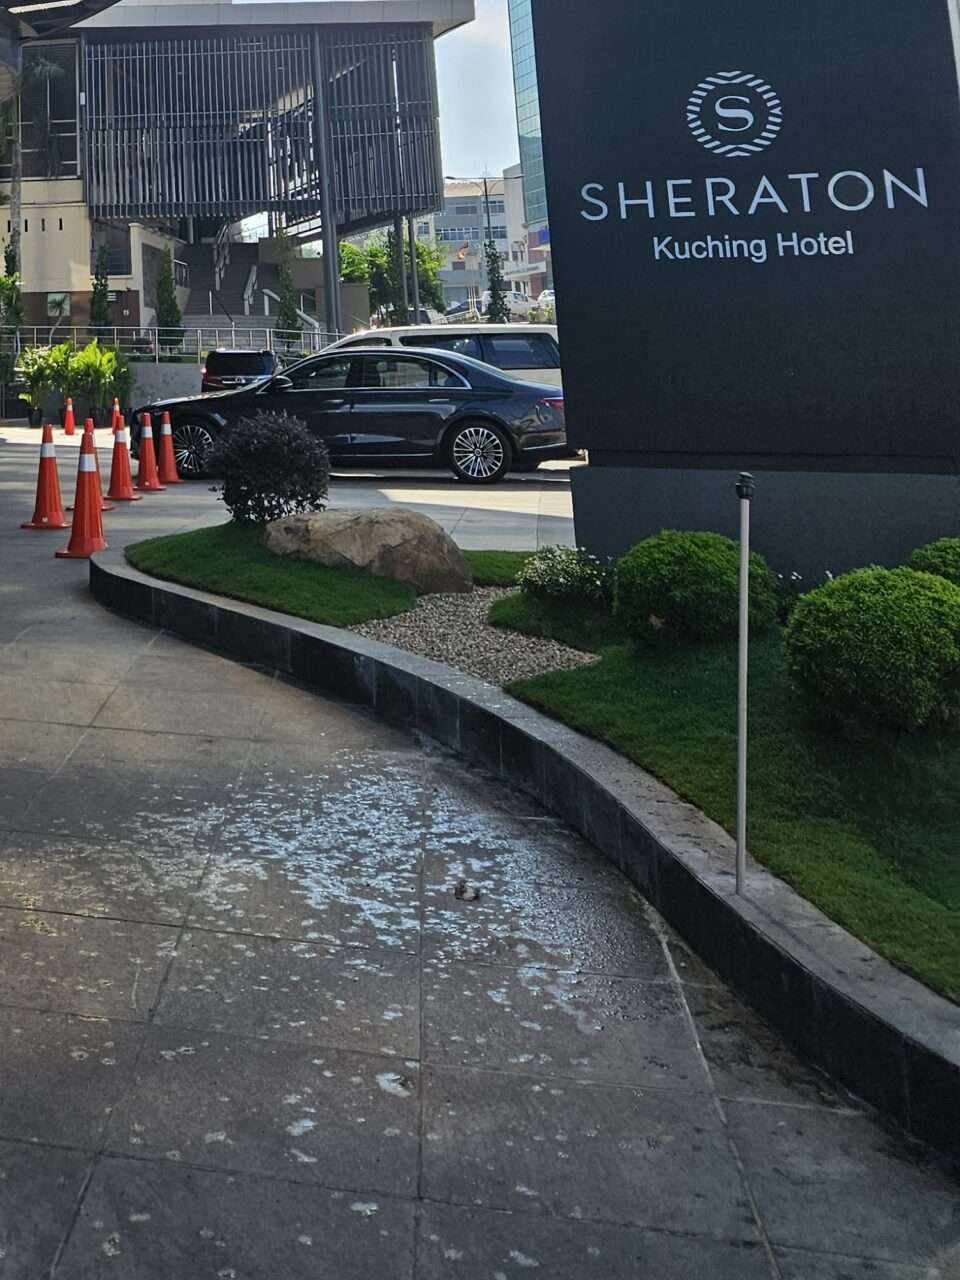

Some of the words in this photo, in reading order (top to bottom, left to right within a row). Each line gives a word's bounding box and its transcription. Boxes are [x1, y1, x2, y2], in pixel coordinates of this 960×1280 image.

[714, 95, 754, 132] S
[580, 167, 929, 221] SHERATON
[653, 234, 768, 264] Kuching
[776, 230, 855, 257] Hotel
